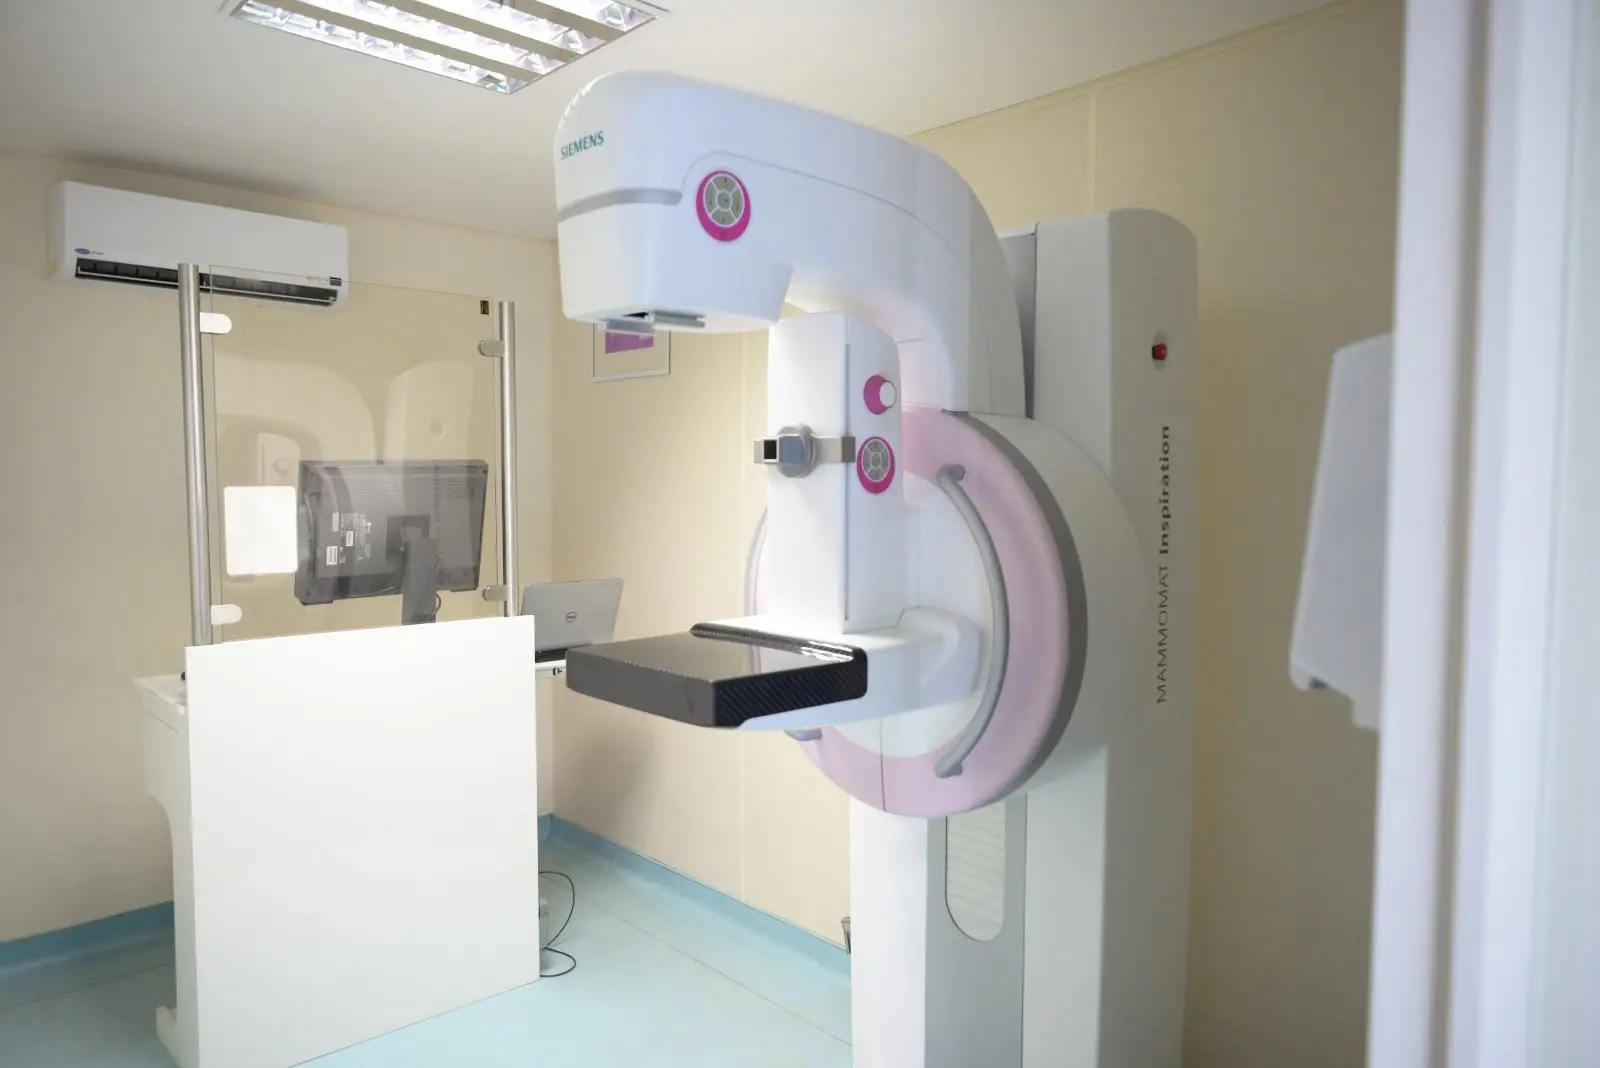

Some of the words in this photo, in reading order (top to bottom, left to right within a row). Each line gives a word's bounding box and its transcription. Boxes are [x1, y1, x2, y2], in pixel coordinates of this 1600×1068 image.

[561, 131, 603, 159] SIEMENS
[1159, 426, 1171, 554] Inspiration
[1156, 564, 1168, 704] MAMMOMAT
